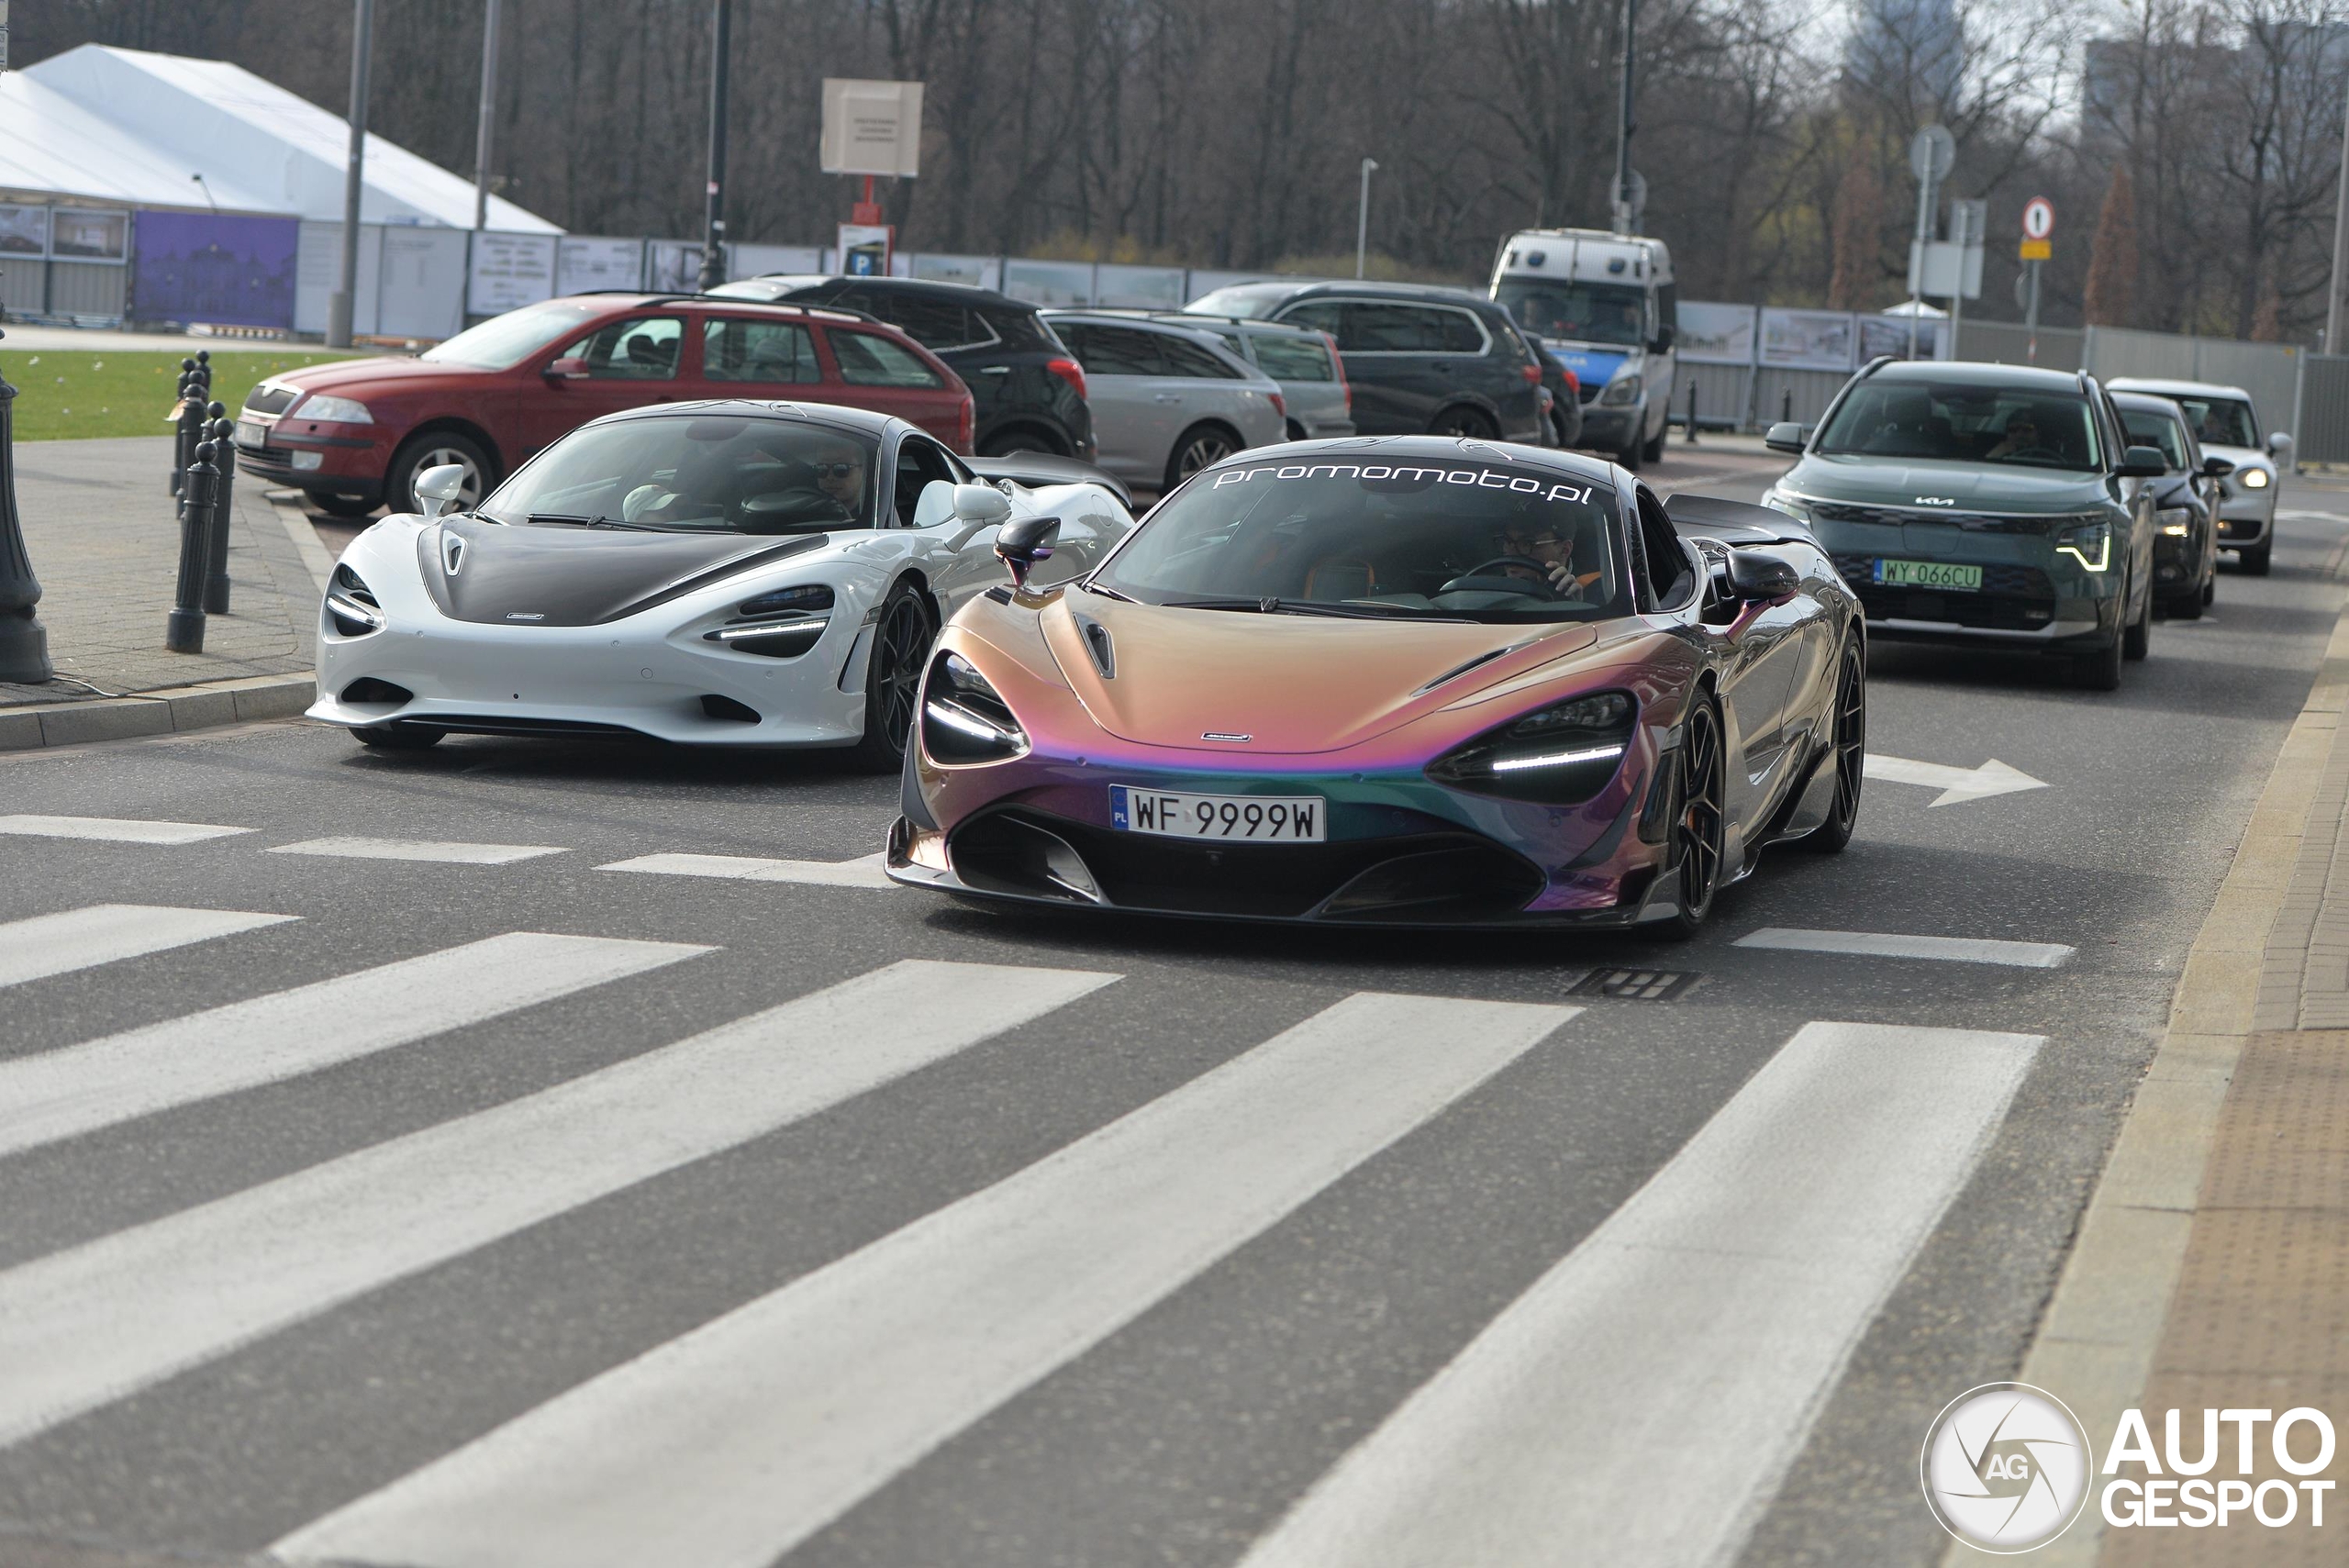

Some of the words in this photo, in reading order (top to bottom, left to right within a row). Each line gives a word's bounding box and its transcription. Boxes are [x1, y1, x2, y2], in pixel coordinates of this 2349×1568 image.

[1213, 465, 1593, 505] promomoto.pl
[1887, 562, 1909, 581] WY
[1918, 564, 1976, 585] 066CU
[1115, 812, 1127, 823] PL
[1135, 795, 1180, 830] WF
[1197, 801, 1314, 837] 9999W
